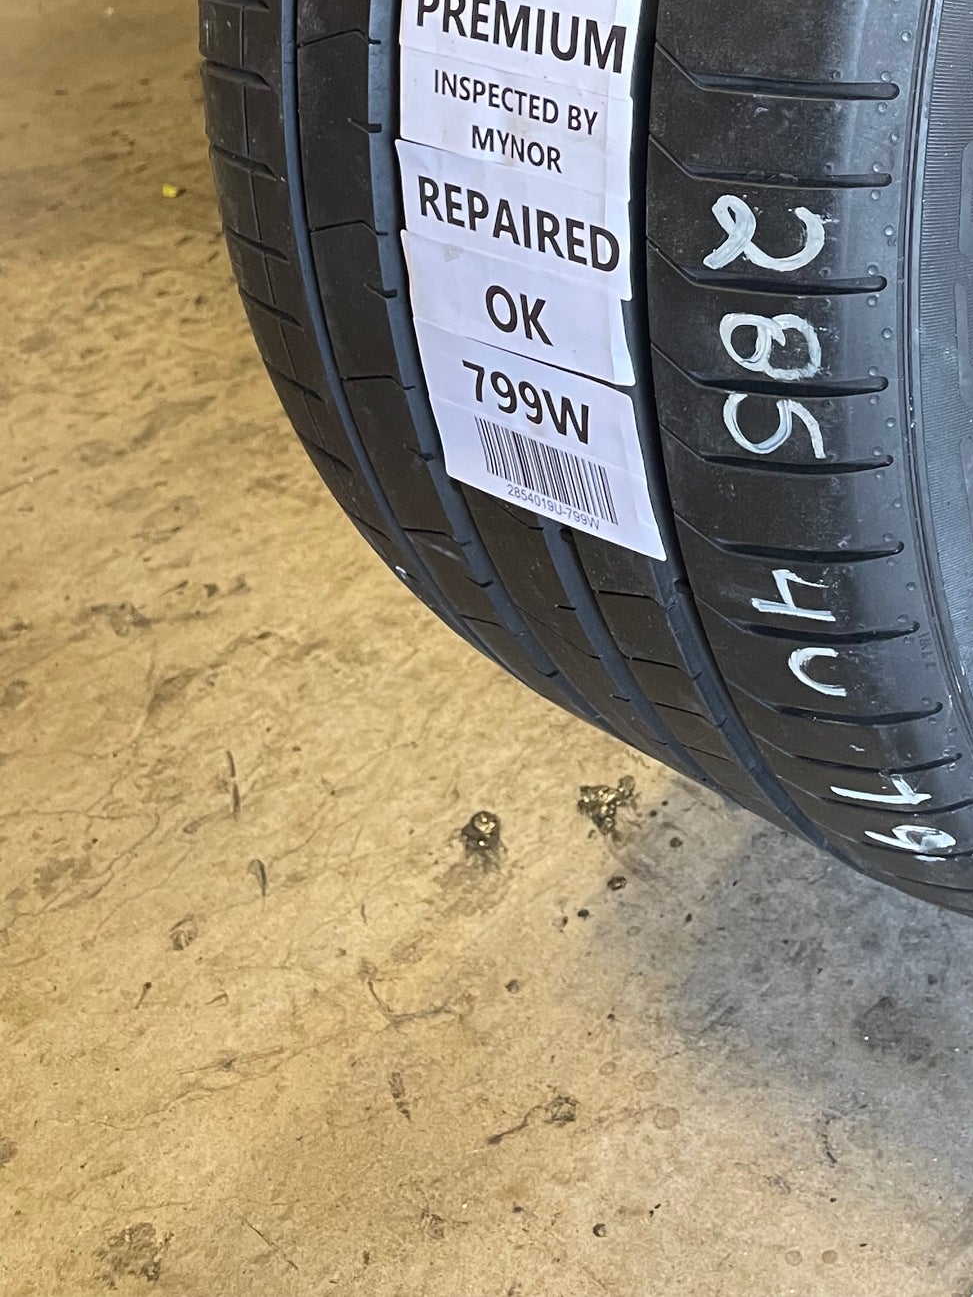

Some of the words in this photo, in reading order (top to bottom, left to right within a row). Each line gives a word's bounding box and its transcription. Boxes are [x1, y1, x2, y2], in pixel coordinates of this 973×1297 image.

[434, 68, 559, 124] INSPECTED
[567, 104, 598, 136] BY
[471, 125, 563, 173] MYNOR
[417, 175, 620, 272] REPAIRED
[484, 284, 554, 347] OK
[703, 193, 827, 459] 285
[462, 359, 589, 445] 799W
[506, 483, 600, 531] 2854019U-799W
